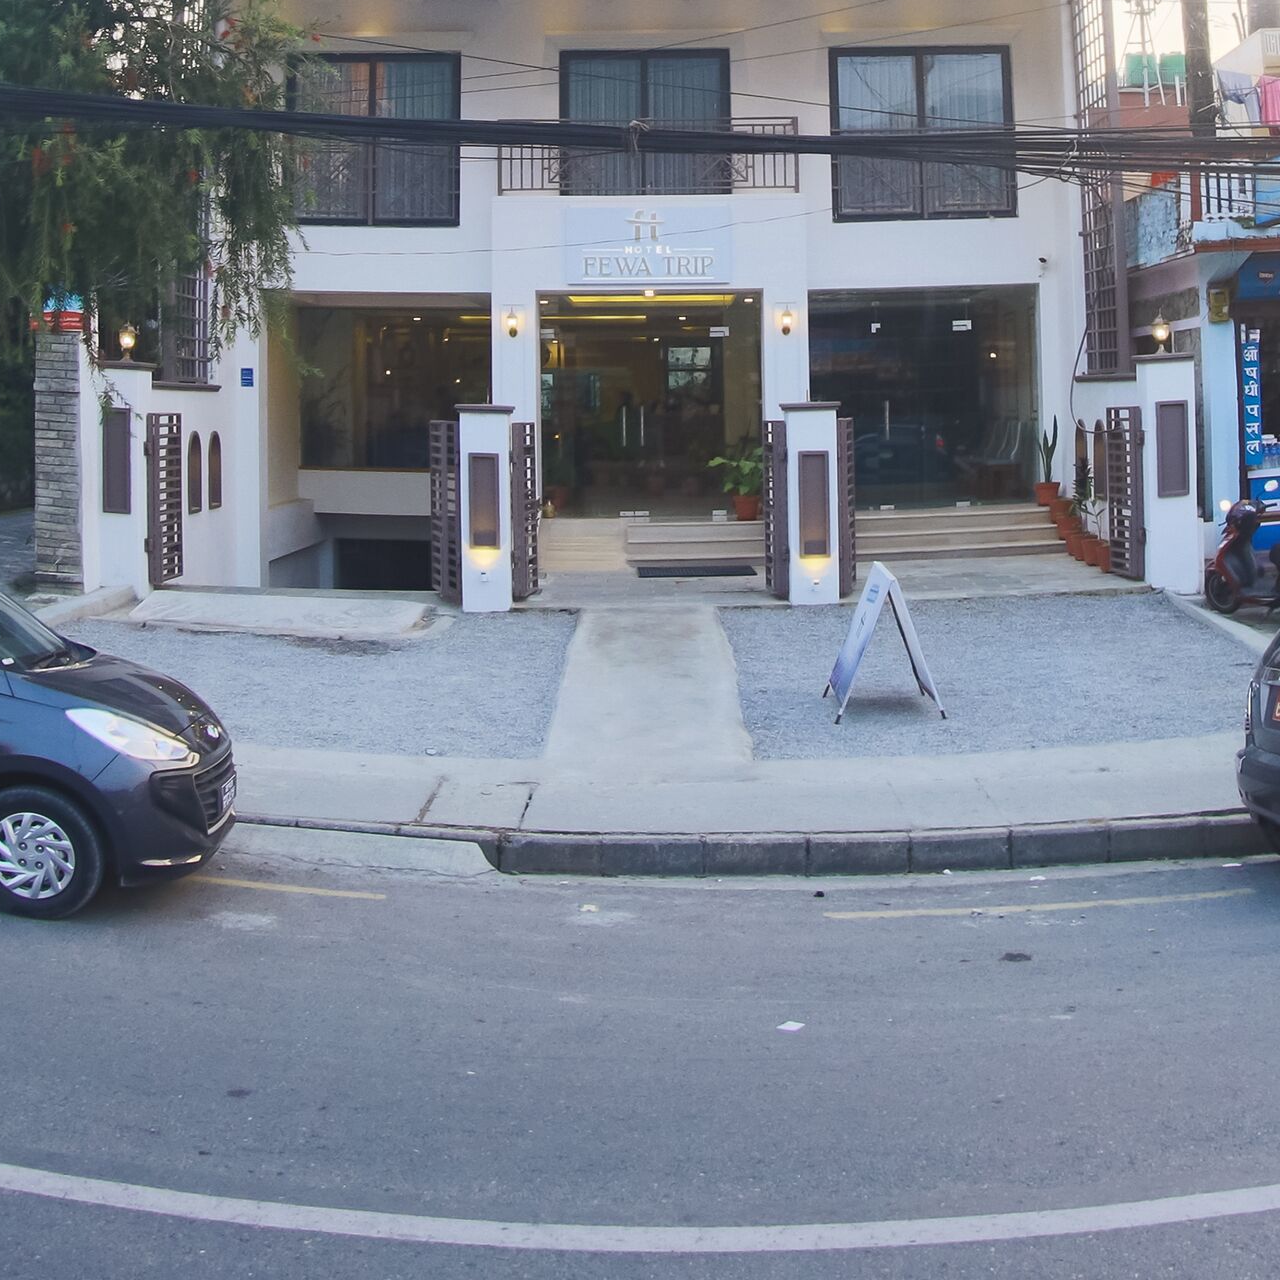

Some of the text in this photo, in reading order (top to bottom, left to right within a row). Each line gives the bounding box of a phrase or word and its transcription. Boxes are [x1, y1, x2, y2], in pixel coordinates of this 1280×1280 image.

[625, 245, 672, 254] HOTEL
[583, 256, 714, 276] FEWA TRIP
